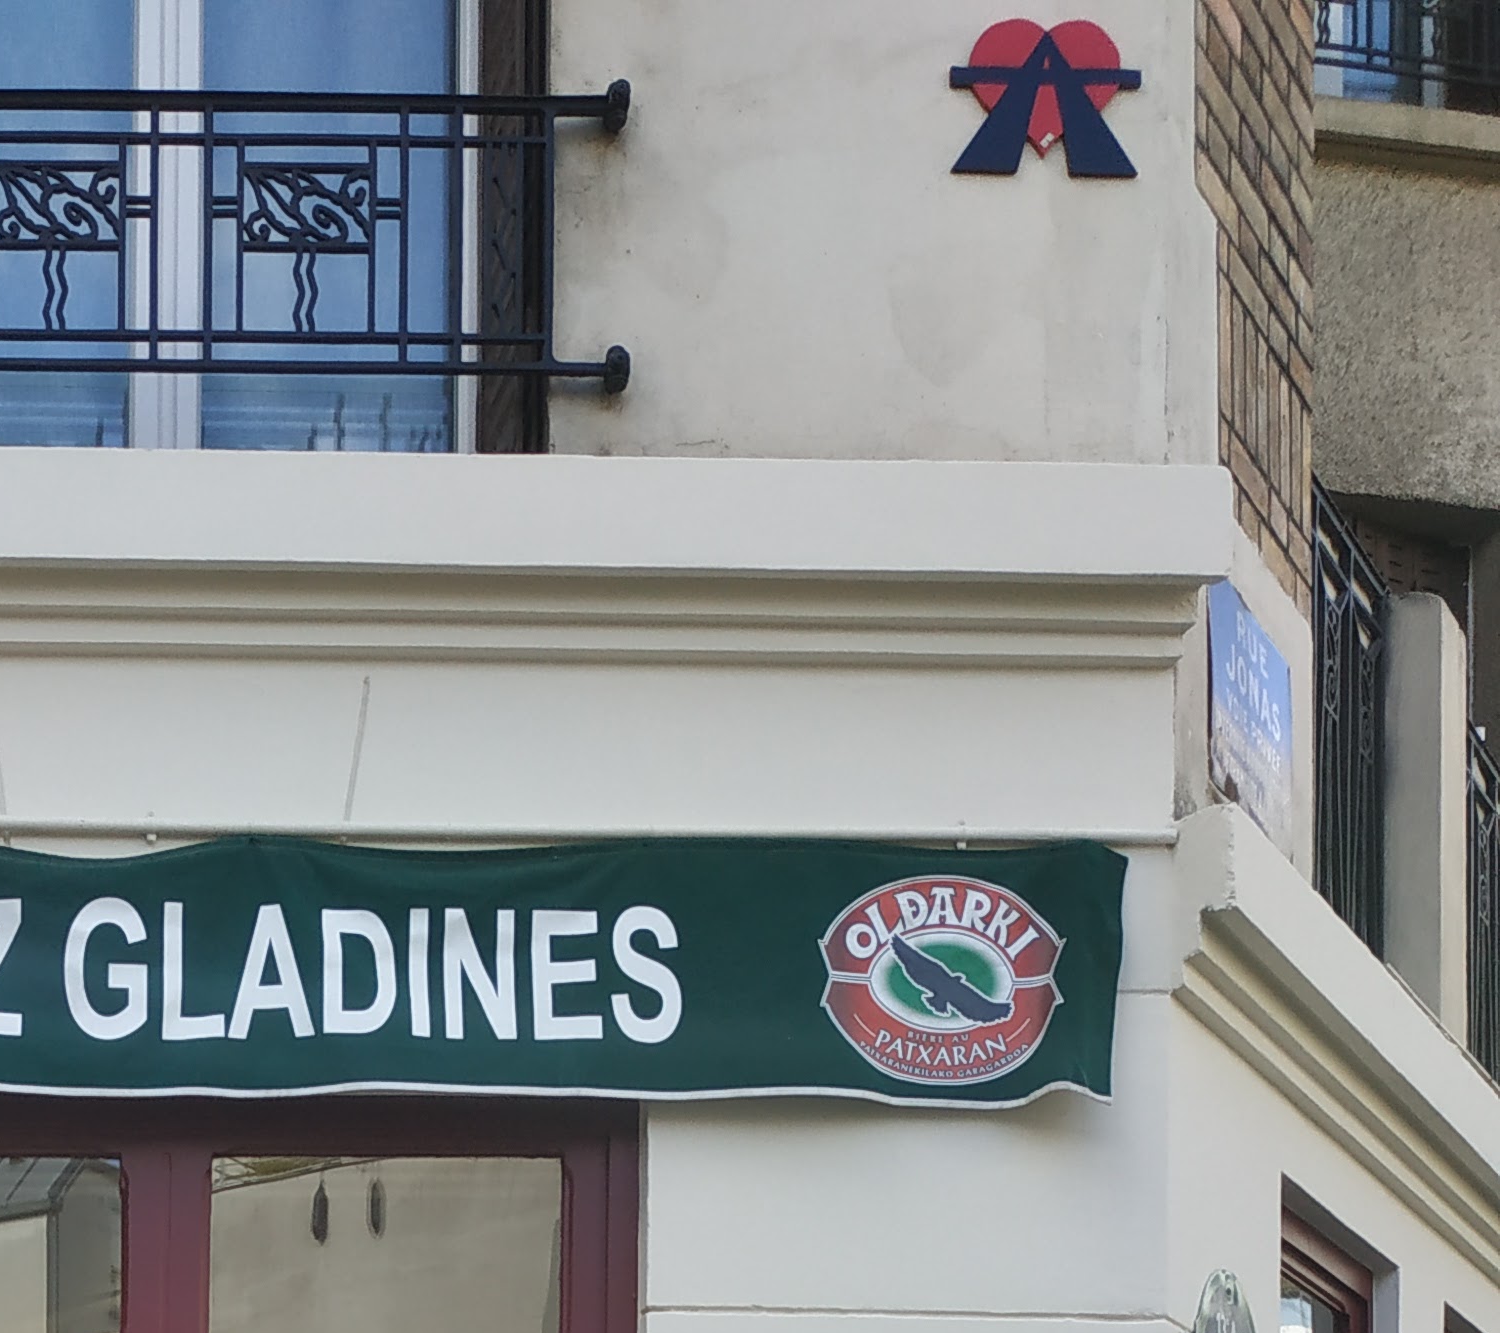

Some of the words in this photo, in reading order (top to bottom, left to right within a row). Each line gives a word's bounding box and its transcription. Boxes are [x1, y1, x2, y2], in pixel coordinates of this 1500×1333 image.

[1236, 610, 1269, 680] RUE
[1226, 643, 1281, 742] JONAS
[844, 886, 1041, 961] OLDARKI
[63, 896, 682, 1045] GLADINES
[874, 1028, 1009, 1067] PATXARAN
[951, 1033, 970, 1043] AU
